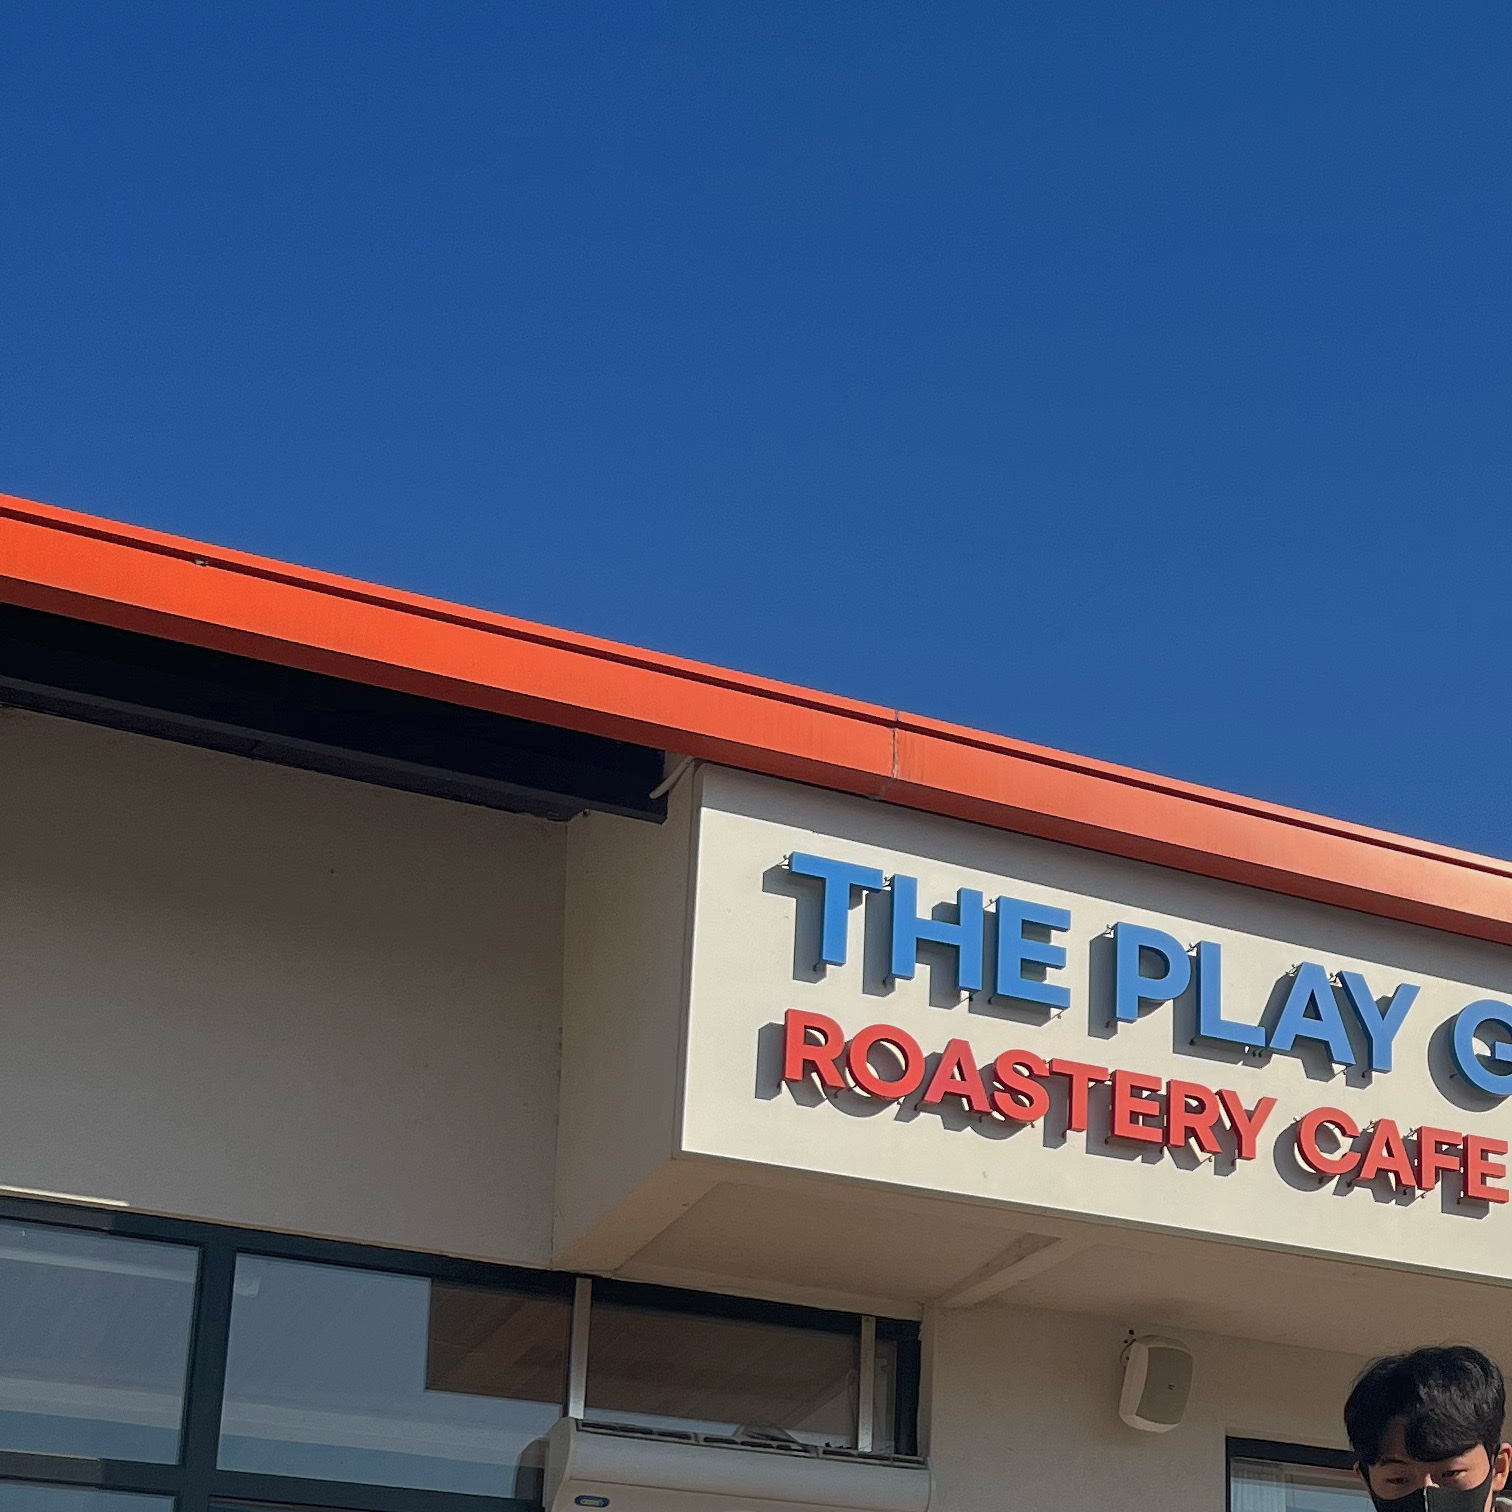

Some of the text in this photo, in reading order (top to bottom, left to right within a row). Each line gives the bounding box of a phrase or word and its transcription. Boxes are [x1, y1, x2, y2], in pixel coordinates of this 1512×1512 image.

[788, 850, 1071, 1009] THE
[1114, 921, 1418, 1072] PLAY
[783, 1007, 1511, 1205] ROASTERY CAFE
